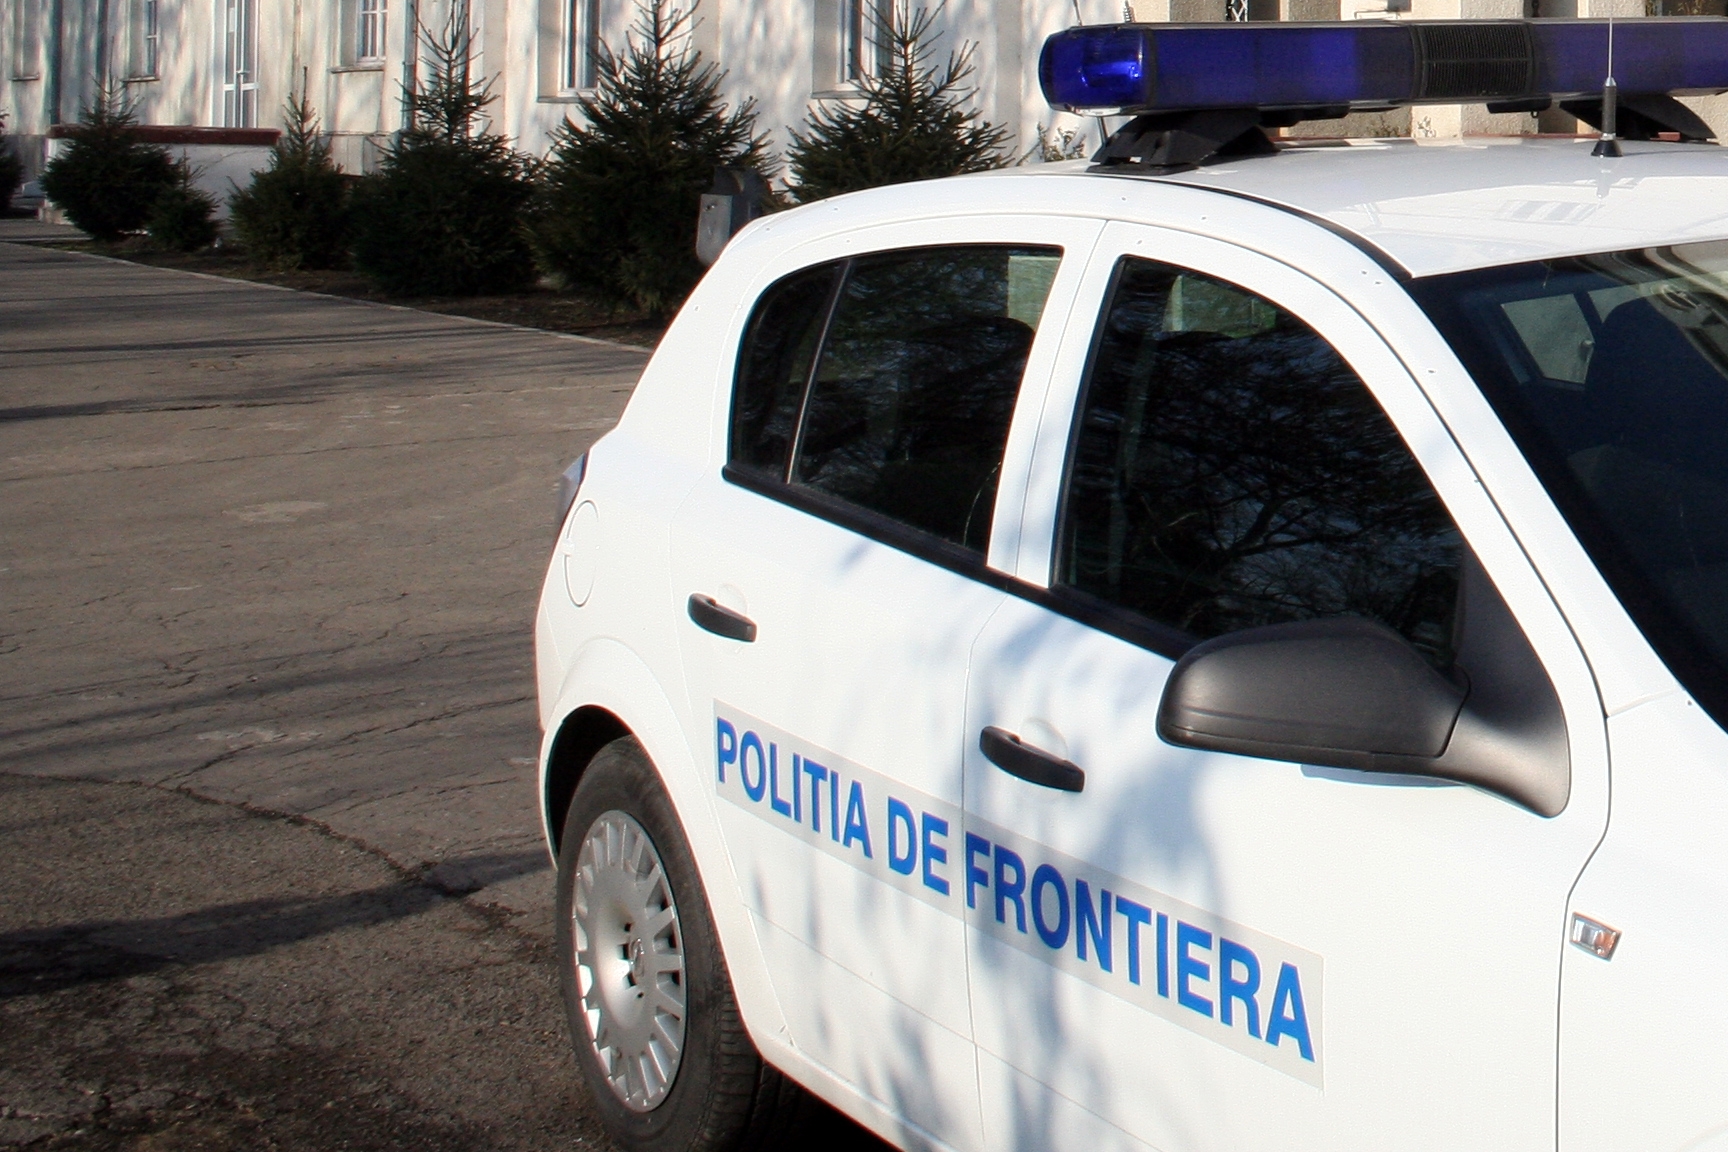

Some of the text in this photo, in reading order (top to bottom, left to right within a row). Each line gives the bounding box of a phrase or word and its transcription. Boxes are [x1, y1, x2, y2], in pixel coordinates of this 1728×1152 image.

[716, 716, 1317, 1064] POLITIA DE FRONTIERA
